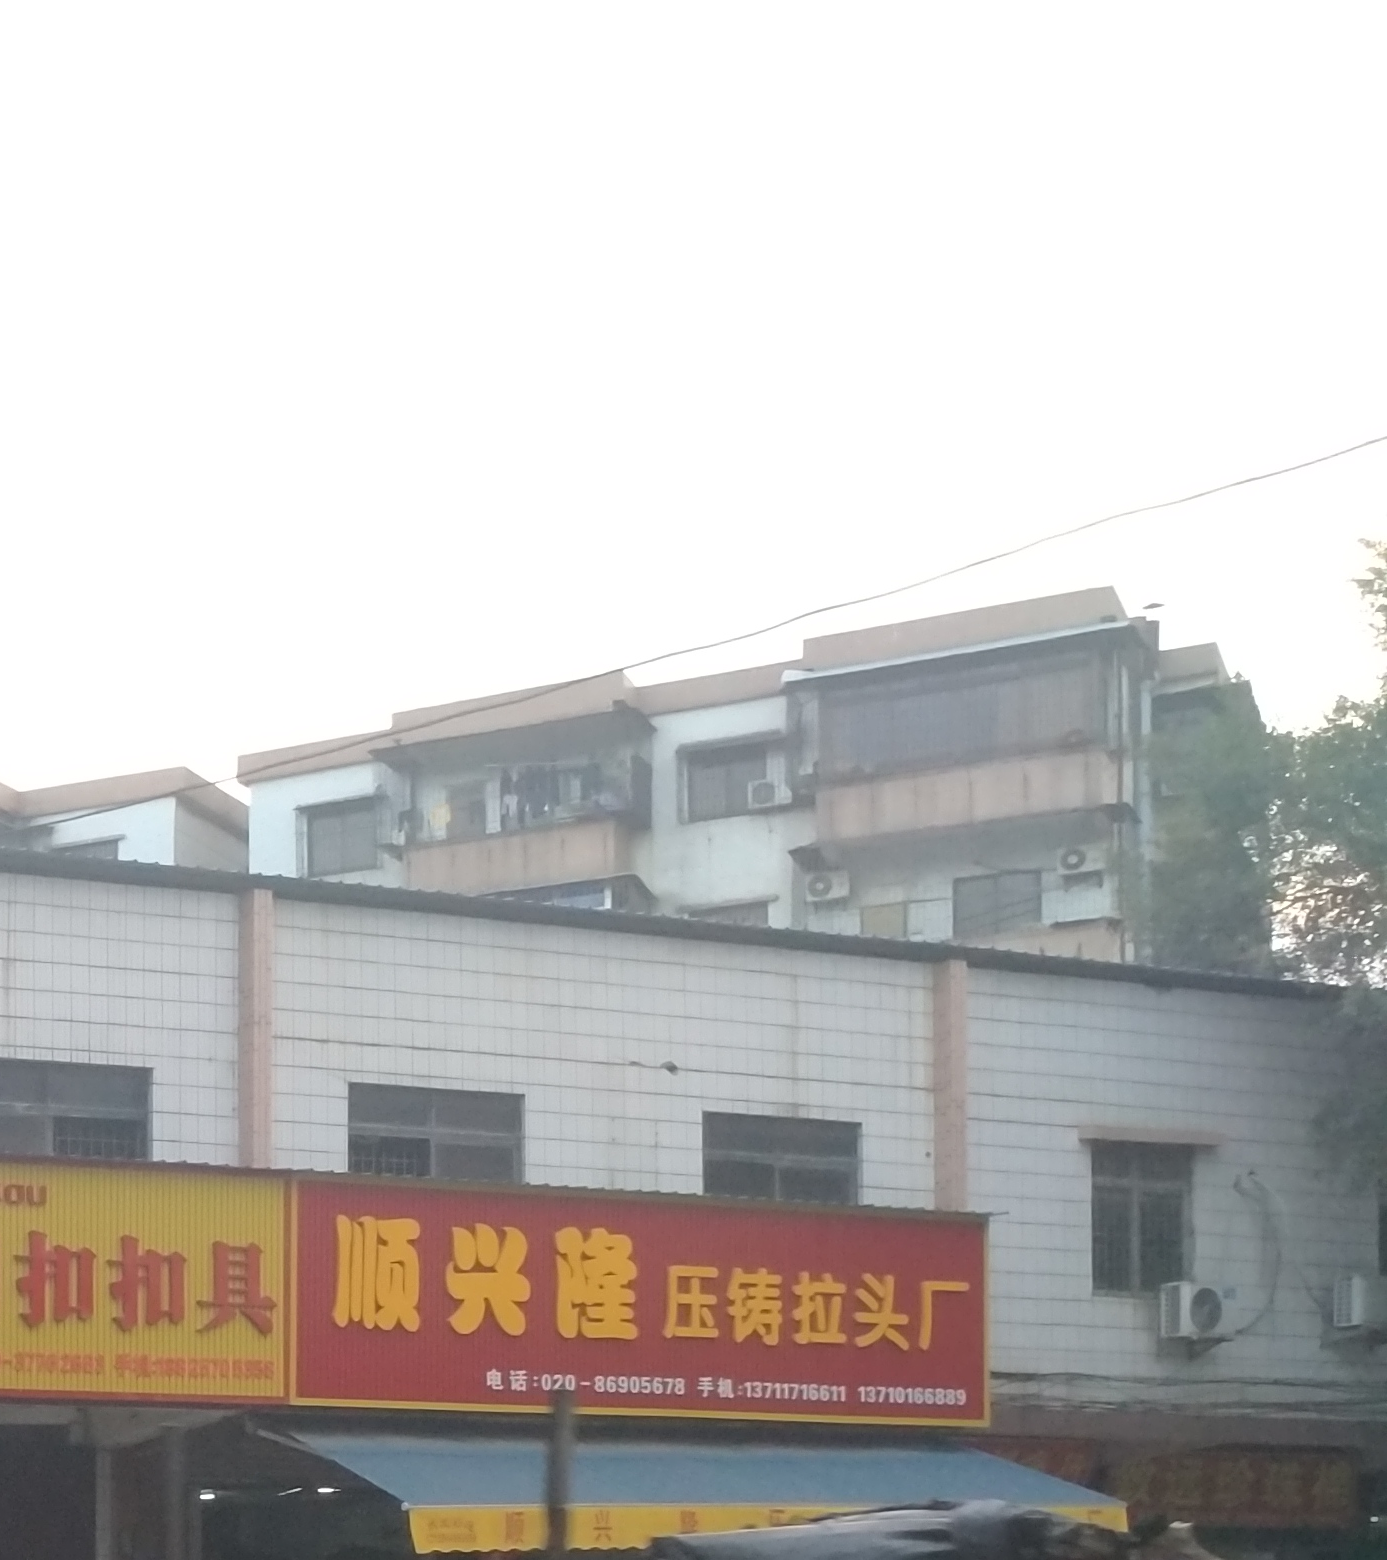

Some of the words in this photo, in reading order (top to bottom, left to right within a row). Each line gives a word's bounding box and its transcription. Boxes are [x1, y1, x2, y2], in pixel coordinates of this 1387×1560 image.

[332, 1213, 639, 1340] 顺兴隆
[662, 1264, 970, 1352] 压铸拉头厂
[856, 1385, 967, 1406] 13710166889
